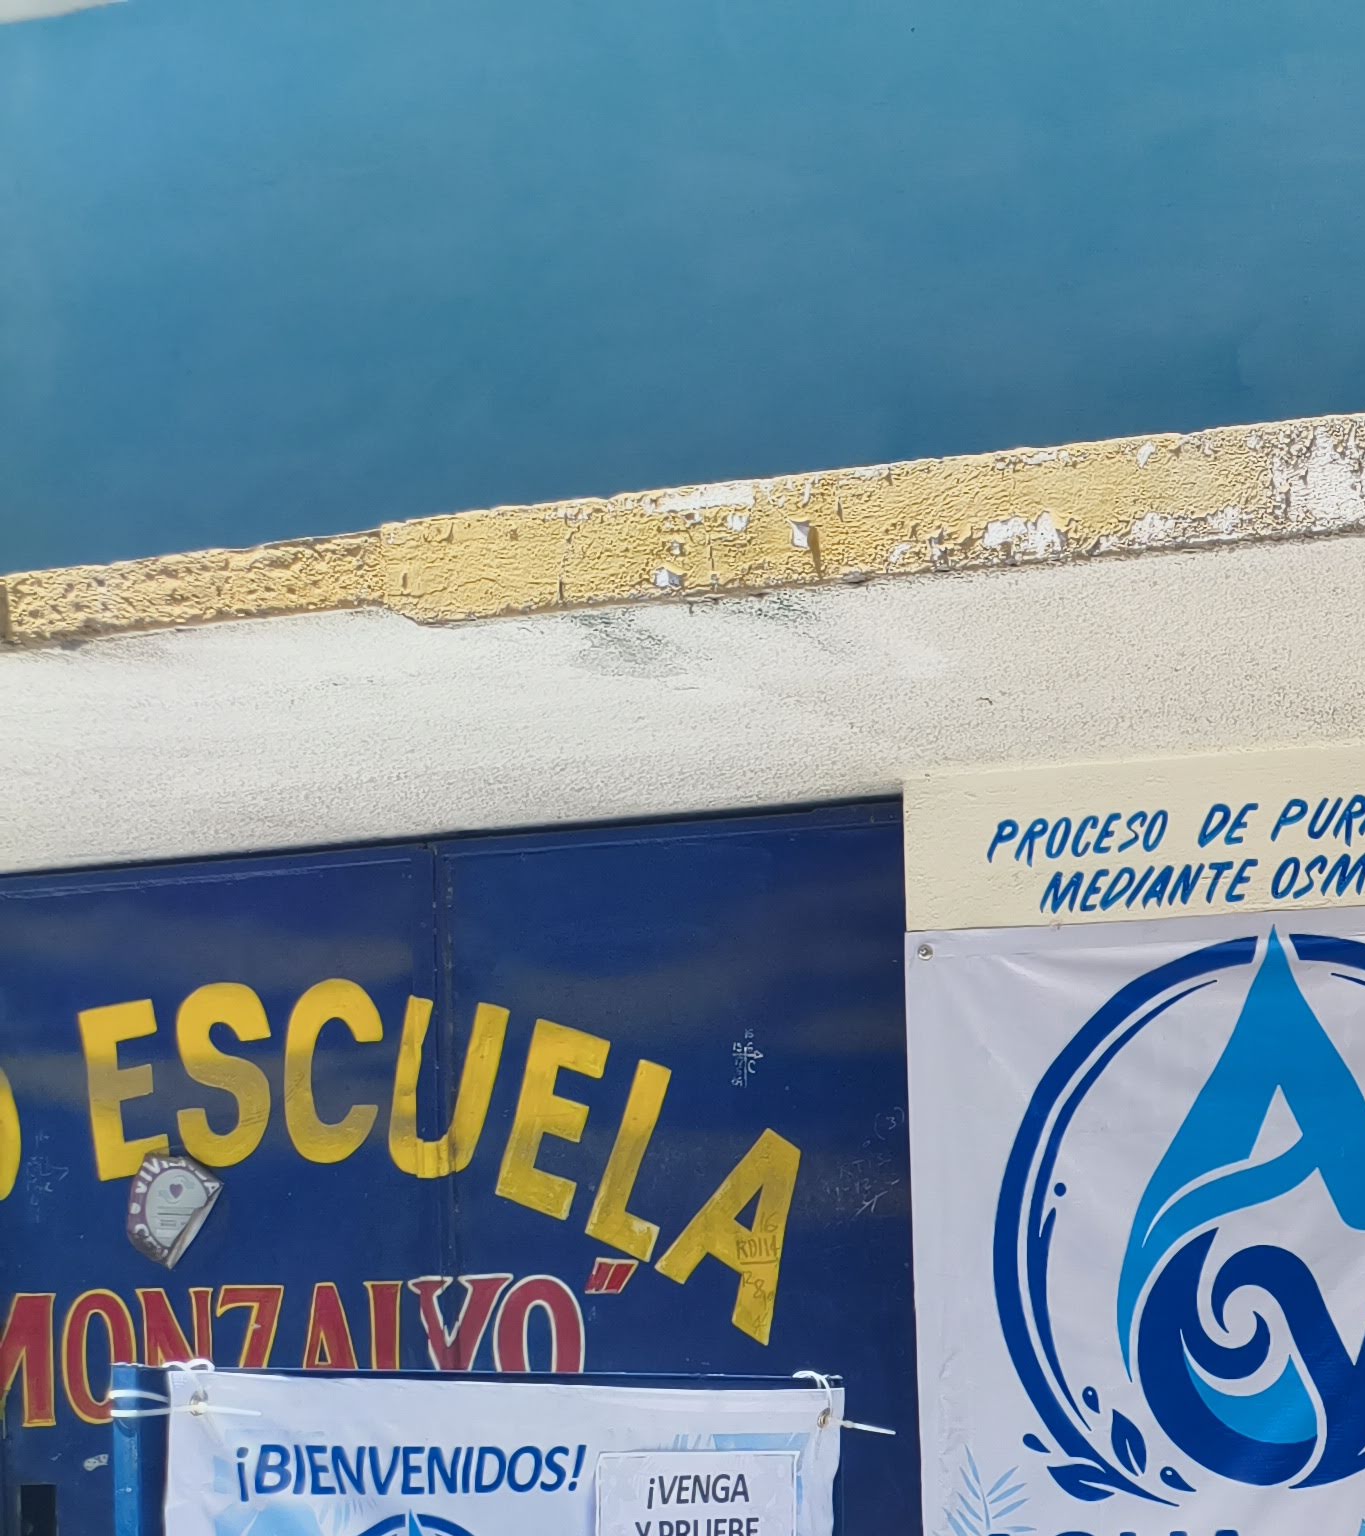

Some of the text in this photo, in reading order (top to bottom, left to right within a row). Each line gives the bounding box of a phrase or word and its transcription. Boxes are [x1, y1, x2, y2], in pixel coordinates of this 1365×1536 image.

[986, 809, 1169, 868] PROCESO
[1198, 802, 1259, 848] DE
[1040, 858, 1259, 915] MEDIANTE
[77, 977, 801, 1346] ESCUELA
[236, 1444, 587, 1502] ¡BIENVENIDOS!
[647, 1474, 750, 1509] ¡VENGA
